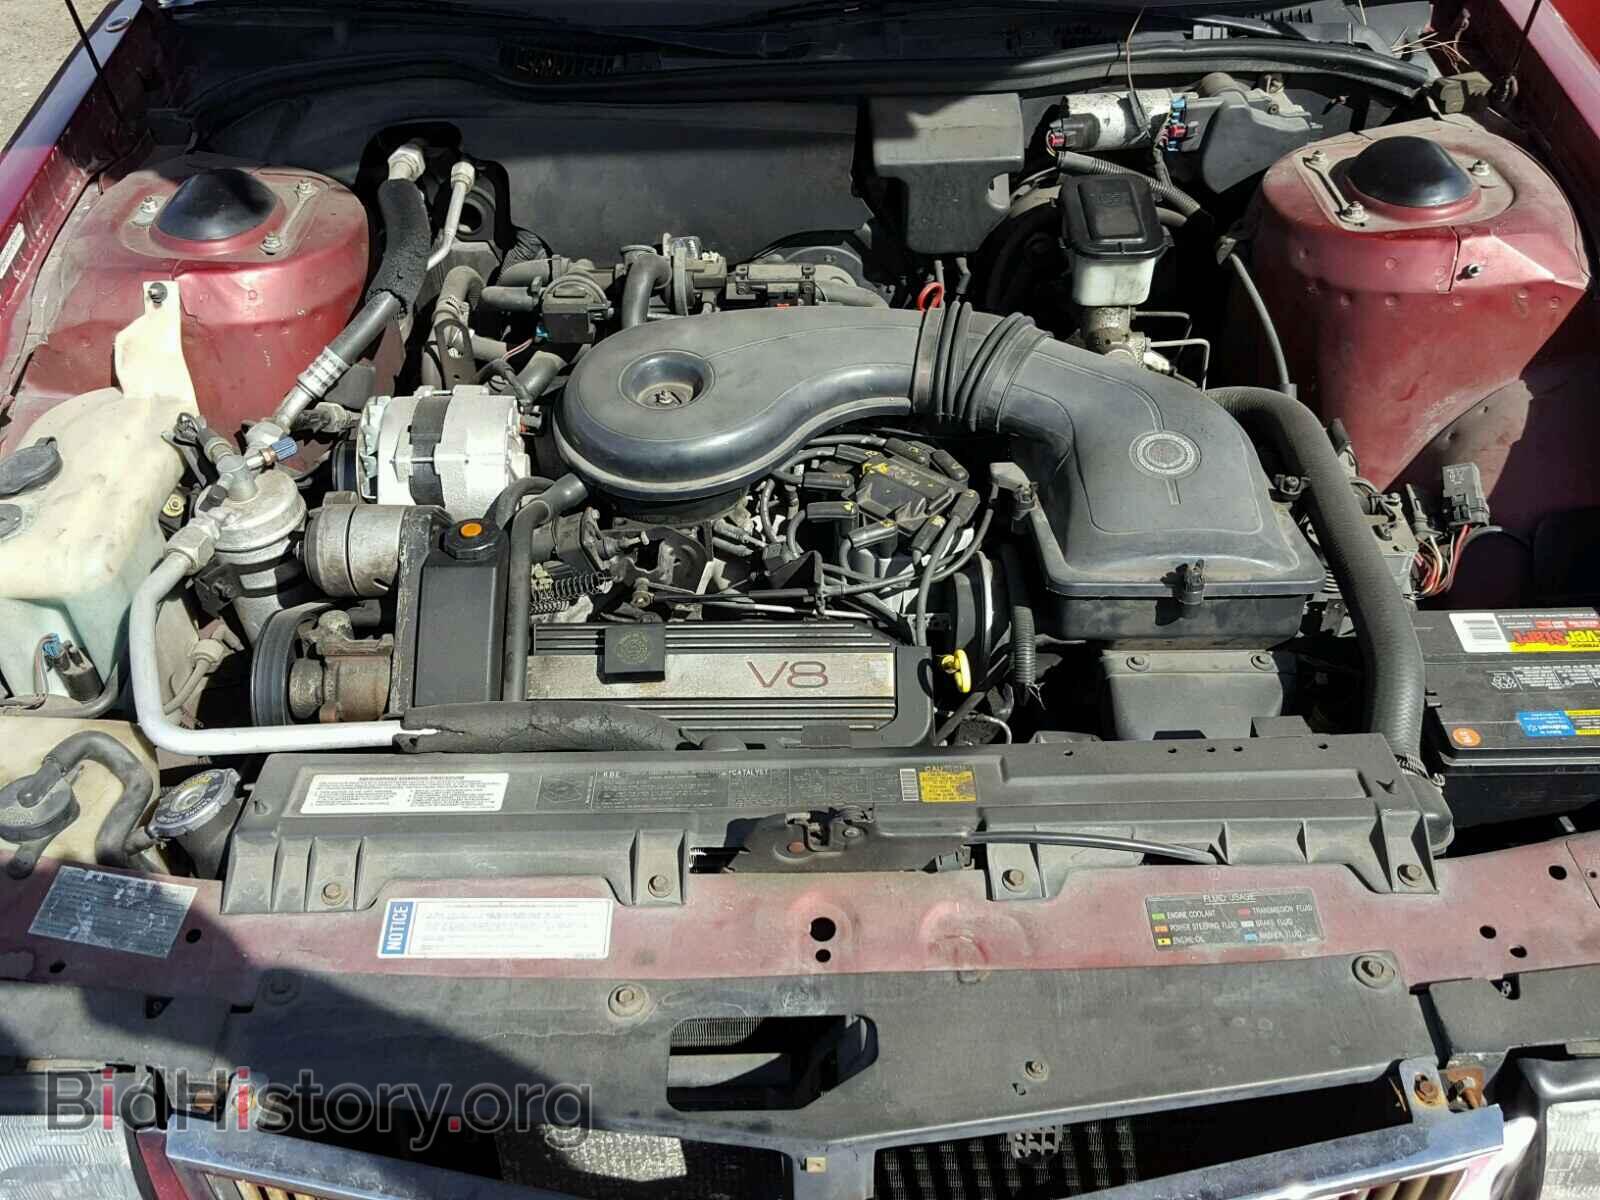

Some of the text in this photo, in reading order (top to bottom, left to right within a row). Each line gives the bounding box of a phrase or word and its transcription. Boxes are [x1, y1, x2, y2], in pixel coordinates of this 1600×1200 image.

[746, 661, 829, 688] V8
[386, 905, 409, 950] NOTICE
[1189, 910, 1215, 919] COOLANT
